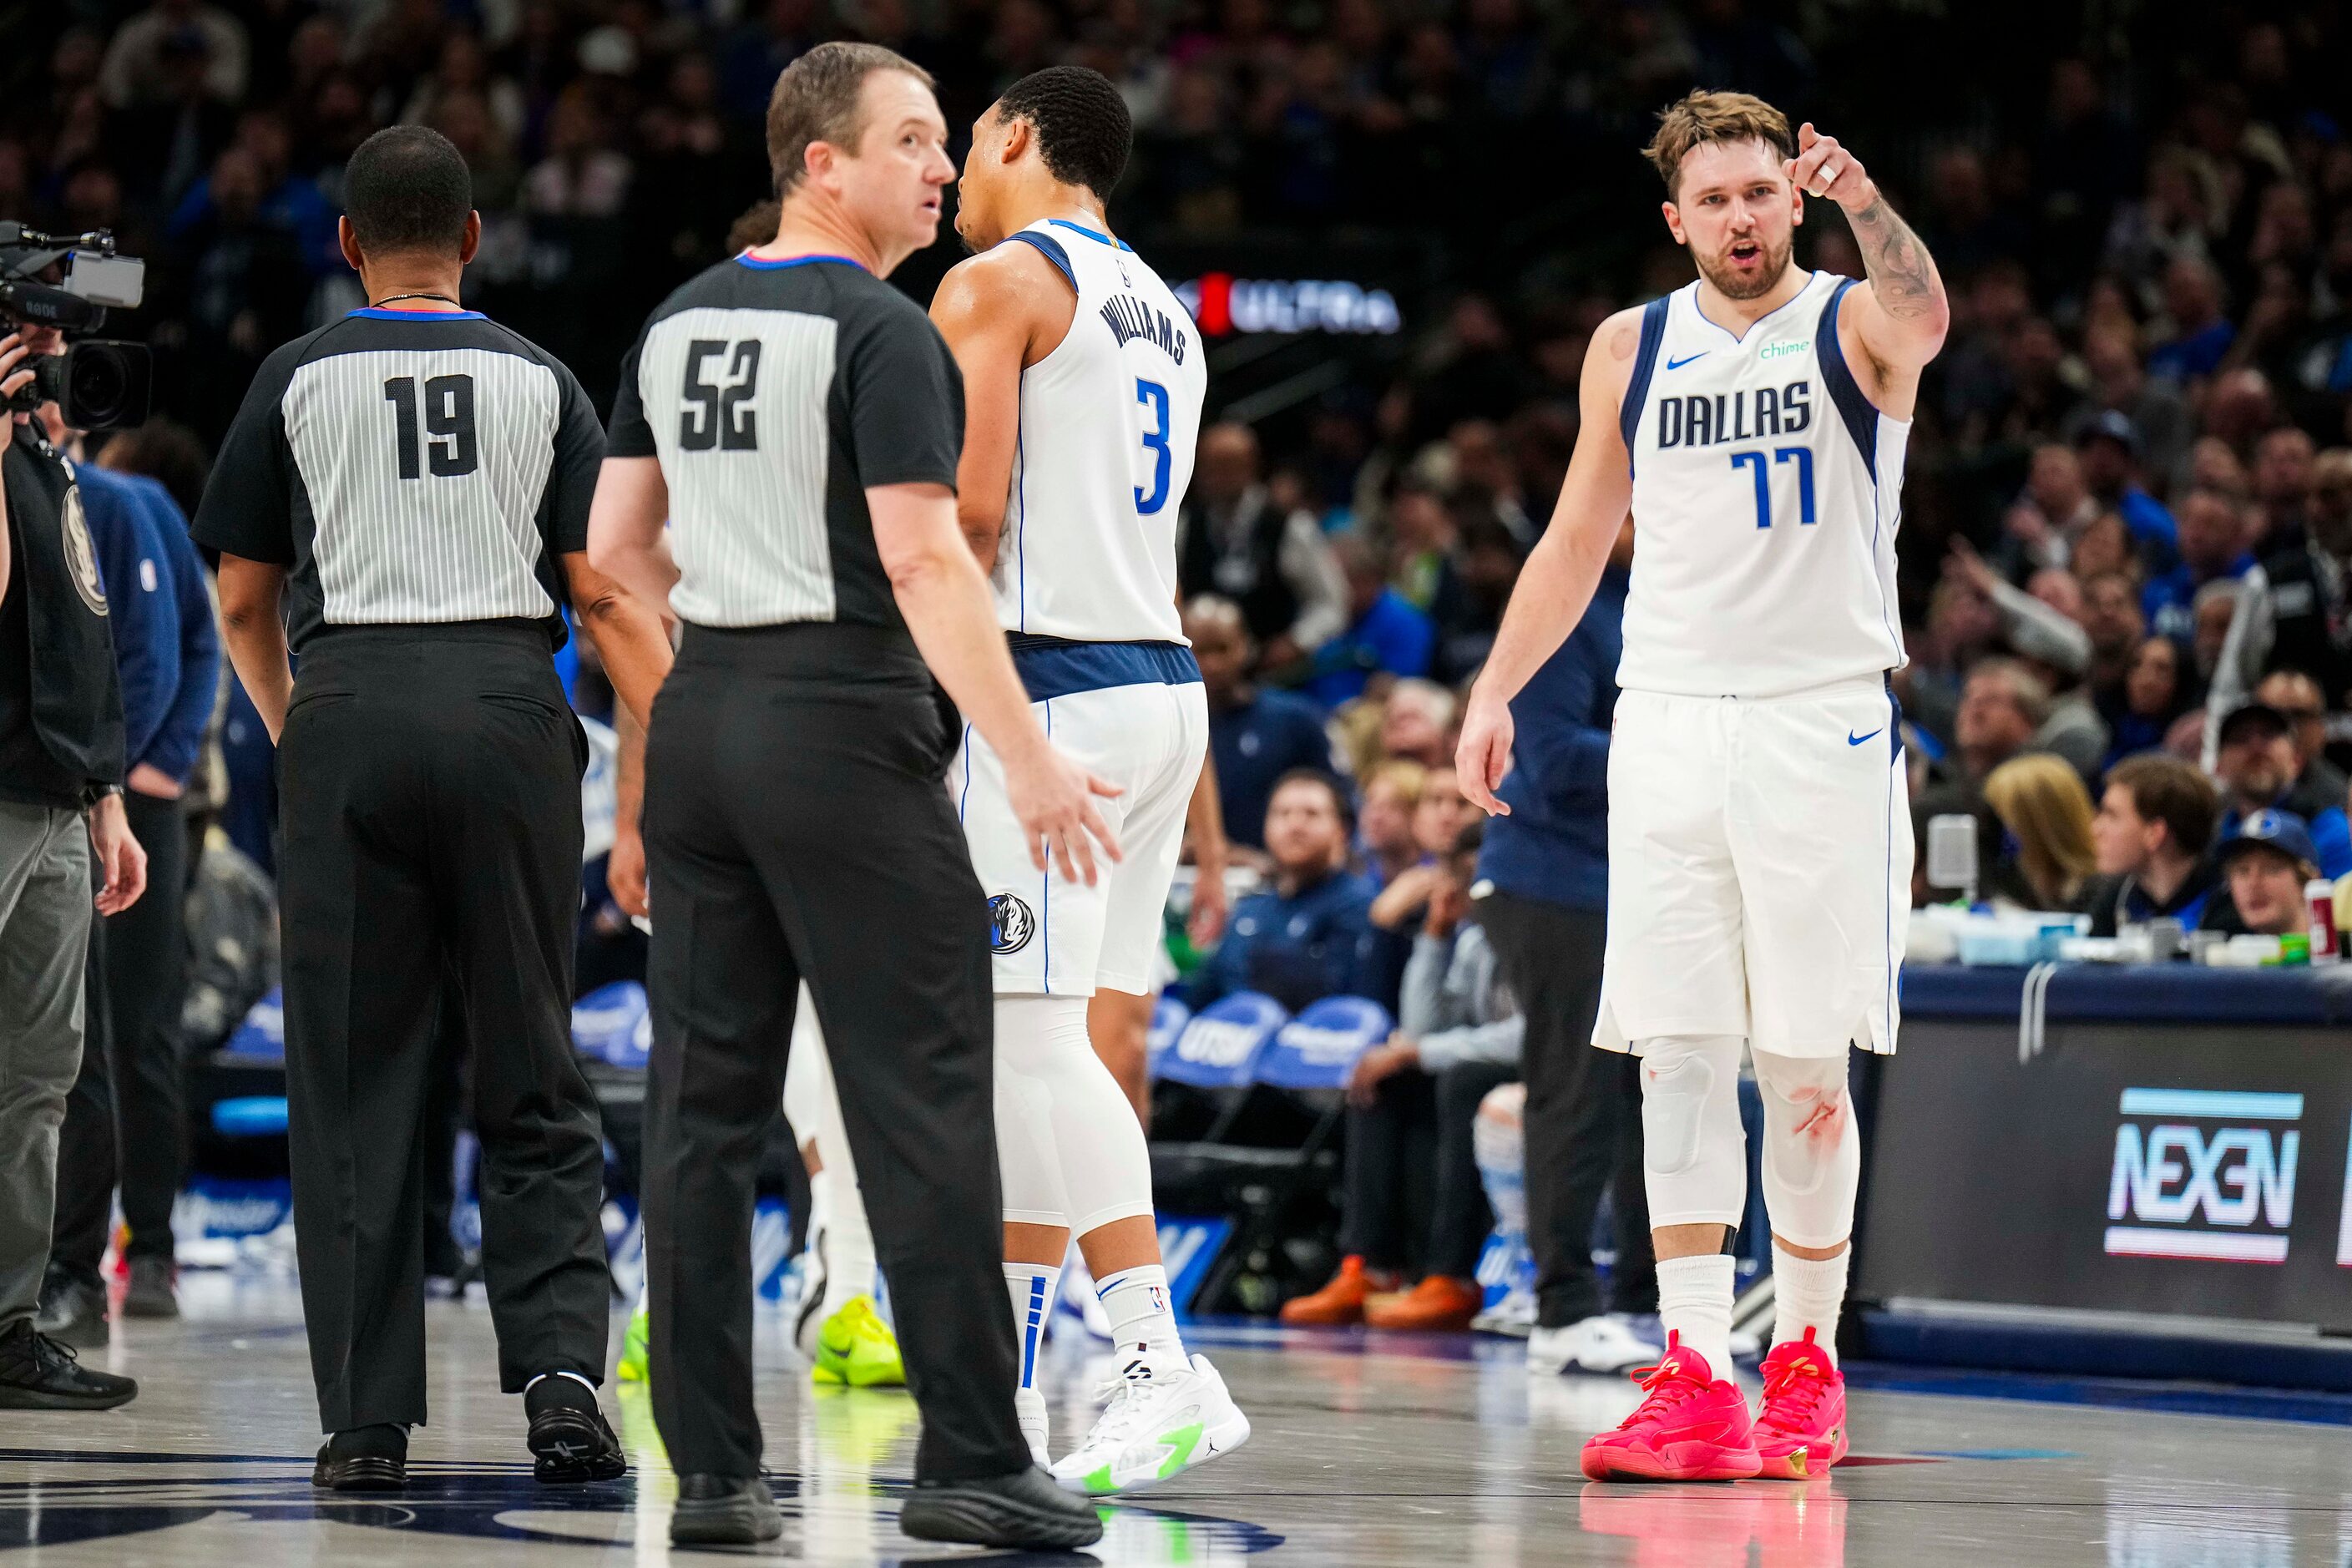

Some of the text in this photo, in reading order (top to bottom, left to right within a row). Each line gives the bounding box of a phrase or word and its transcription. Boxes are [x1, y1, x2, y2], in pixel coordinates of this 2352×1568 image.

[1099, 295, 1186, 367] WILLIAMS
[1760, 340, 1810, 360] chime
[383, 373, 478, 479] 19
[680, 339, 761, 450] 52
[1657, 380, 1813, 451] DALLAS
[1134, 375, 1171, 516] 3
[1729, 446, 1818, 530] 77
[2107, 1123, 2301, 1228] NEXEN
